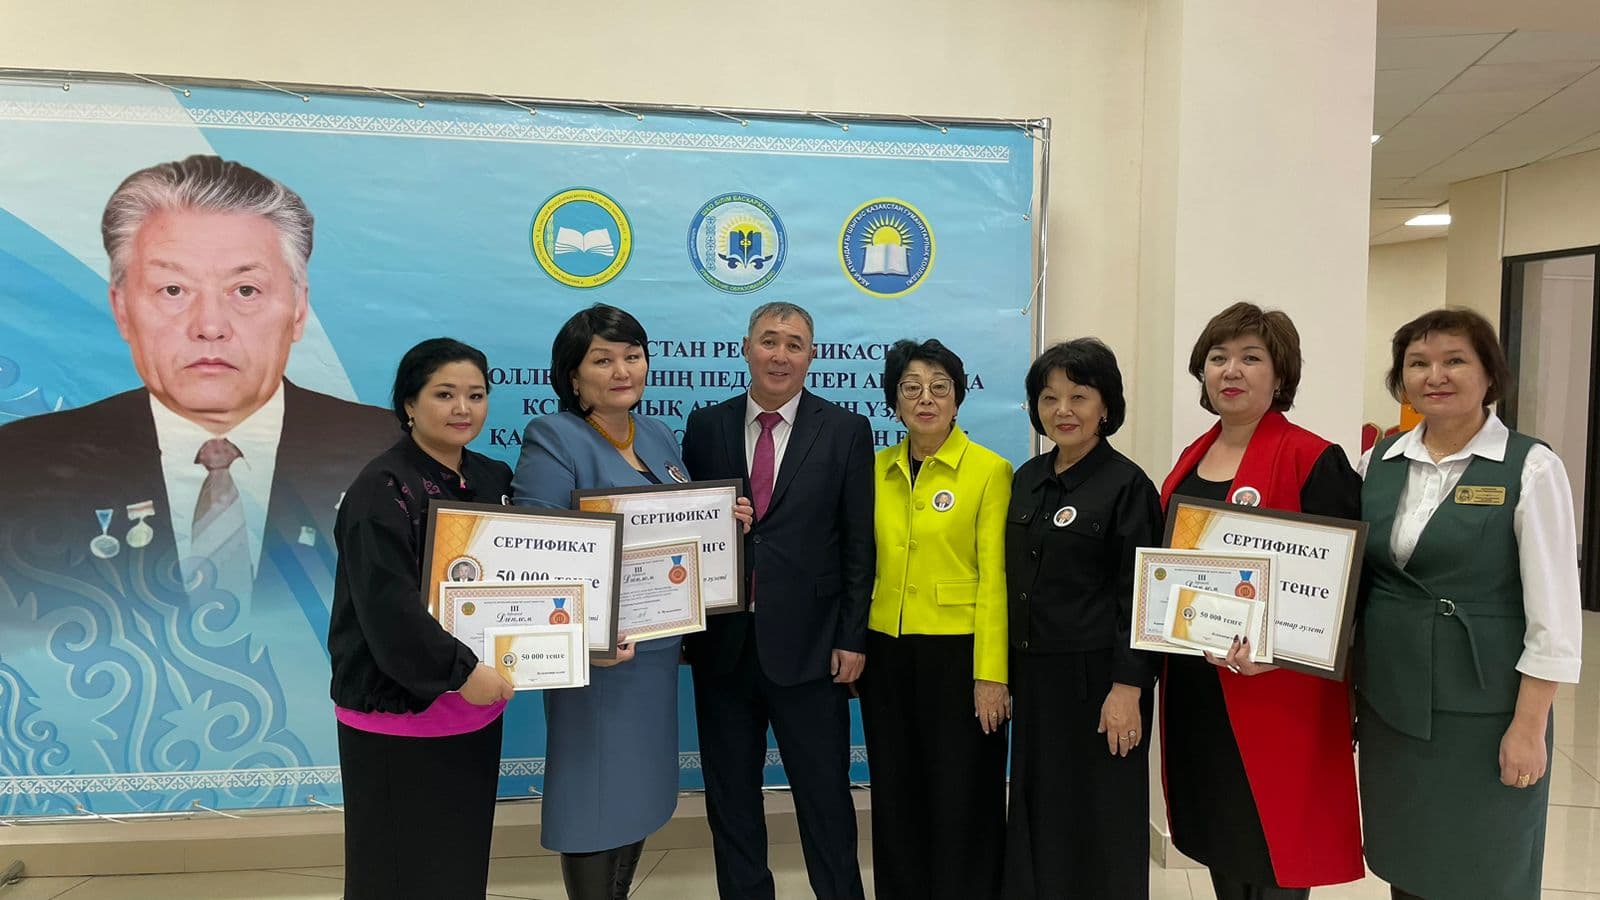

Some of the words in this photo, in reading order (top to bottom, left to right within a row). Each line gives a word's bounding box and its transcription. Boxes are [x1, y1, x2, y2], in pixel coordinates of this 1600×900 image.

[631, 508, 720, 526] СЕРТИФИКАТ
[493, 536, 597, 553] СЕРТИФИКАТ
[702, 541, 726, 553] ңге
[1223, 533, 1330, 560] СЕРТИФИКАТ
[1280, 580, 1330, 600] теңге
[1209, 613, 1221, 621] 000
[521, 653, 530, 661] 50
